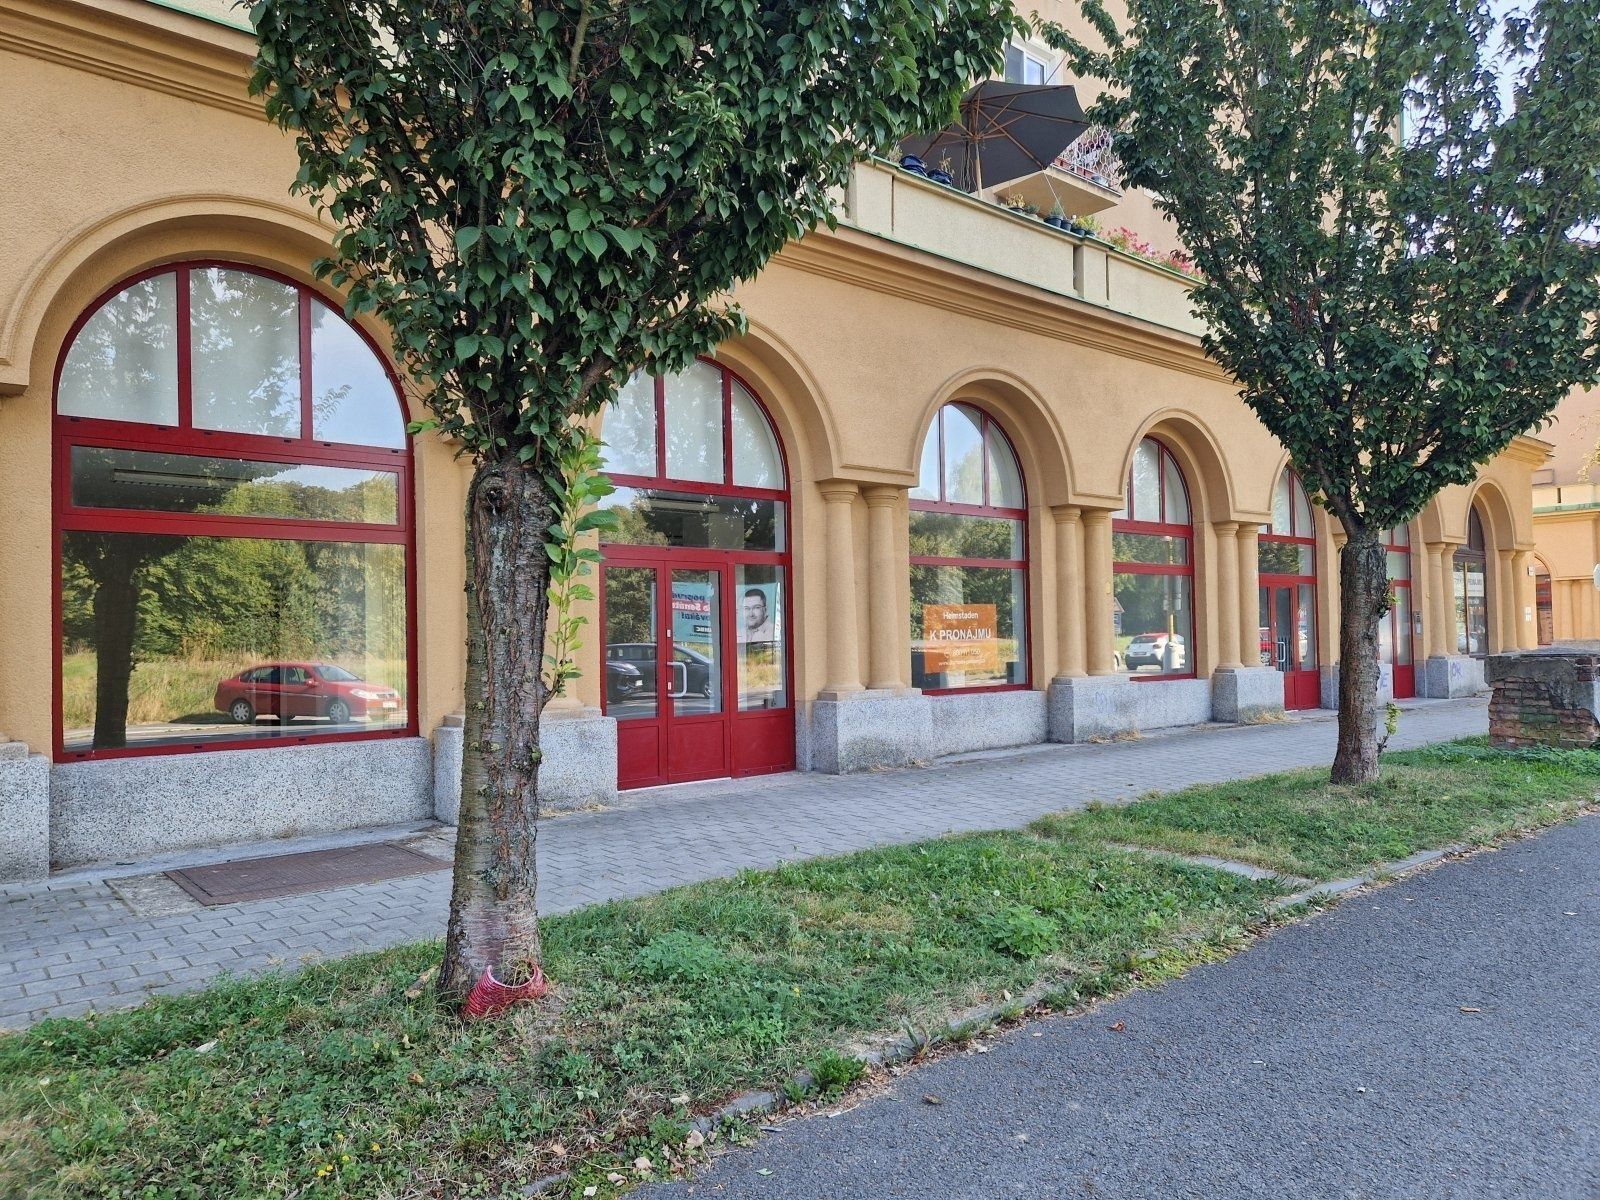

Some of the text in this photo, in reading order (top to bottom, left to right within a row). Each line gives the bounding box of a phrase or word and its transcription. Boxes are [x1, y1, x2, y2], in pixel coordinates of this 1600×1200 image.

[943, 611, 979, 620] Heimstaden
[929, 626, 991, 641] K PRONÁJMU
